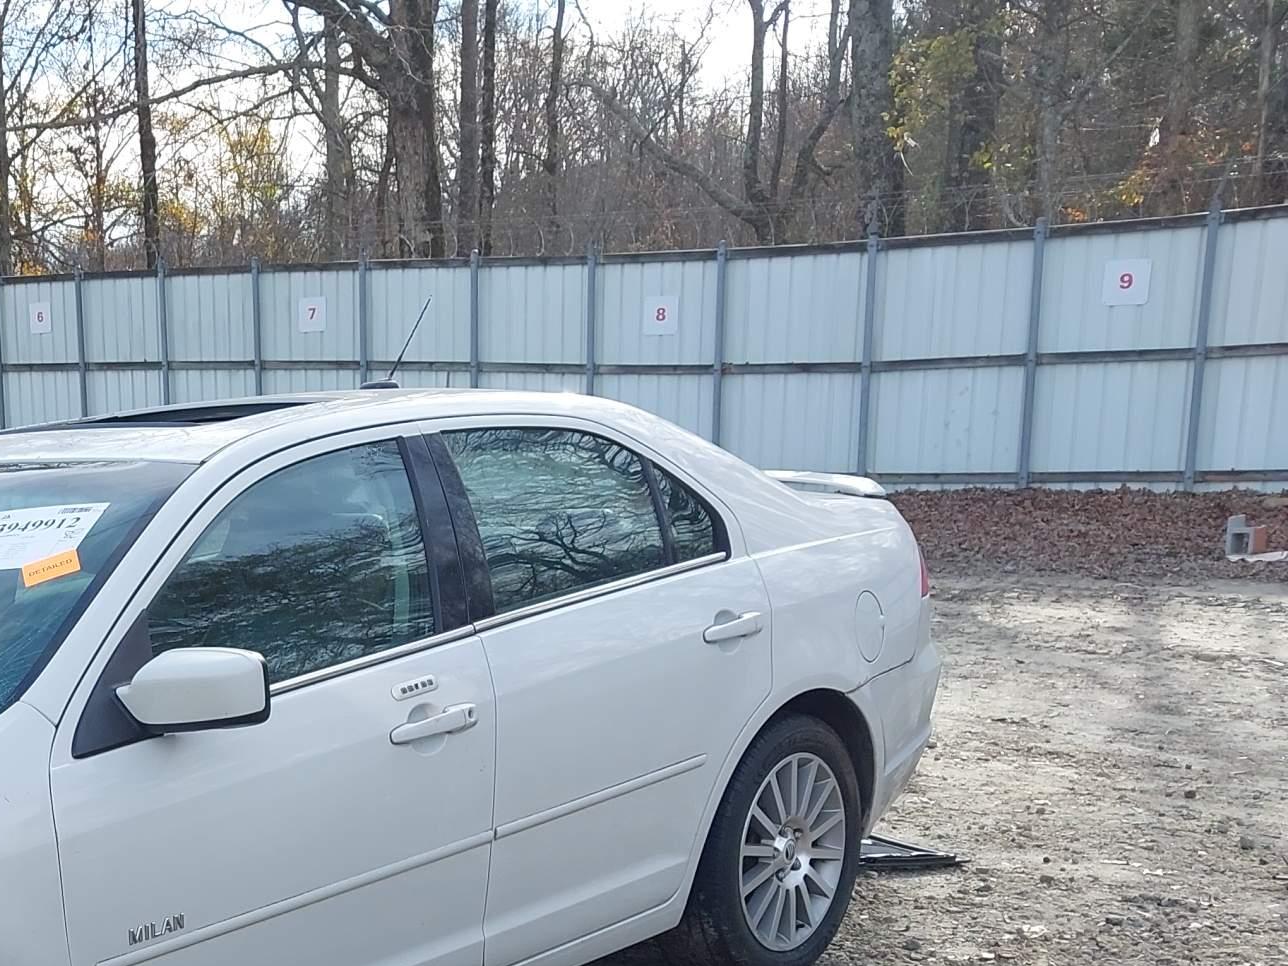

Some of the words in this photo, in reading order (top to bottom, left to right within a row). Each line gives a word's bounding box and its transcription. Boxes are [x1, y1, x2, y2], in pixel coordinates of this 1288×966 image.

[1119, 272, 1134, 289] 9
[37, 311, 44, 323] 6
[308, 307, 316, 320] 7
[655, 307, 666, 322] 8
[28, 558, 73, 577] DETAILED
[128, 912, 185, 945] MILAN
